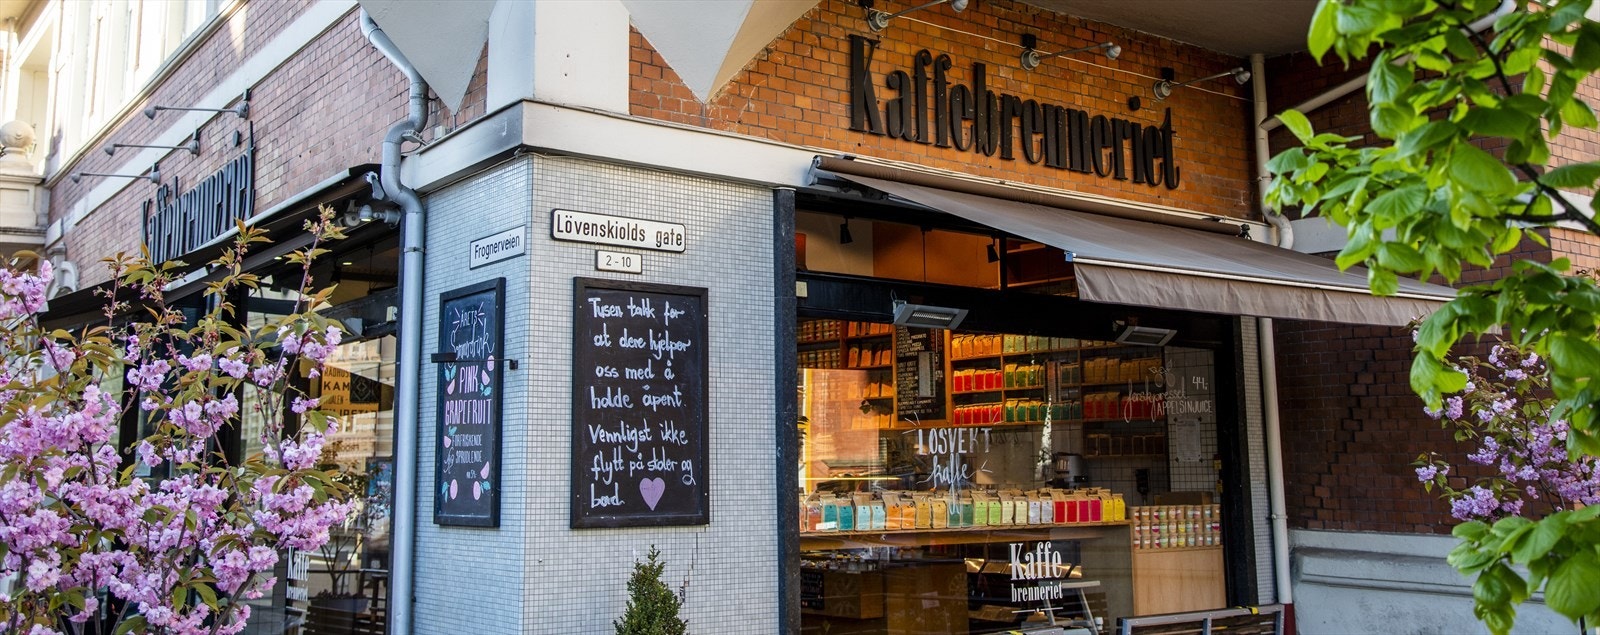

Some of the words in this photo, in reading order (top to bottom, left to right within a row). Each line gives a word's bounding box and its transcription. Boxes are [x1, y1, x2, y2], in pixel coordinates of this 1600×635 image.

[848, 34, 1181, 190] Kaffebrenneriet
[141, 121, 255, 266] Kaffebrenneriet
[474, 234, 520, 260] Frognerveien
[556, 214, 646, 242] Lövenskiolds
[655, 228, 683, 248] gate
[588, 297, 623, 318] Tusen
[627, 296, 656, 319] takk
[664, 300, 685, 326] for
[593, 322, 612, 347] at
[619, 327, 647, 348] dere
[649, 328, 692, 360] hjelper
[459, 365, 479, 394] PINK
[595, 365, 620, 378] oss
[625, 358, 656, 380] med
[664, 359, 675, 380] å
[445, 398, 492, 426] GRAPEFRUIT
[590, 385, 634, 409] holde
[1157, 400, 1213, 416] APPELSINJUICE
[588, 418, 652, 453] Vennligst
[659, 420, 688, 446] ikke
[591, 445, 625, 485] flytt
[629, 452, 645, 477] på
[647, 446, 678, 472] stoler
[681, 459, 697, 485] og
[916, 453, 977, 515] kaffe
[286, 544, 310, 582] Kaffe
[1009, 541, 1062, 580] Kaffe
[1011, 581, 1064, 603] brenneriet
